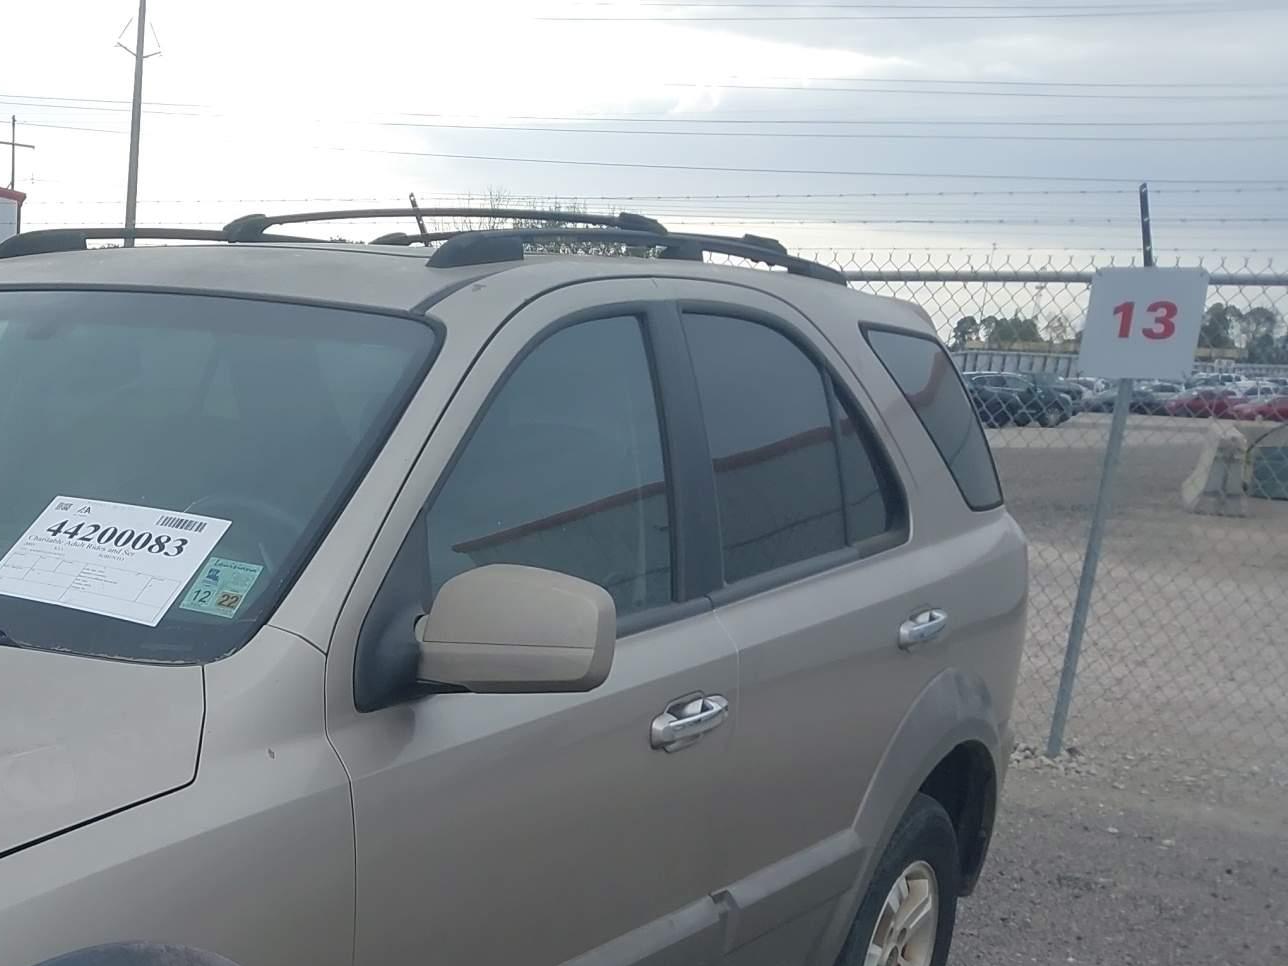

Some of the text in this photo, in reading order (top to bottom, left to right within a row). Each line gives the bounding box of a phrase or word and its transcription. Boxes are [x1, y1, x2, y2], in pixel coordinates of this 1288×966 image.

[1113, 300, 1178, 340] 13
[47, 520, 188, 557] 44200083
[193, 589, 211, 603] 12
[218, 594, 239, 608] 22
